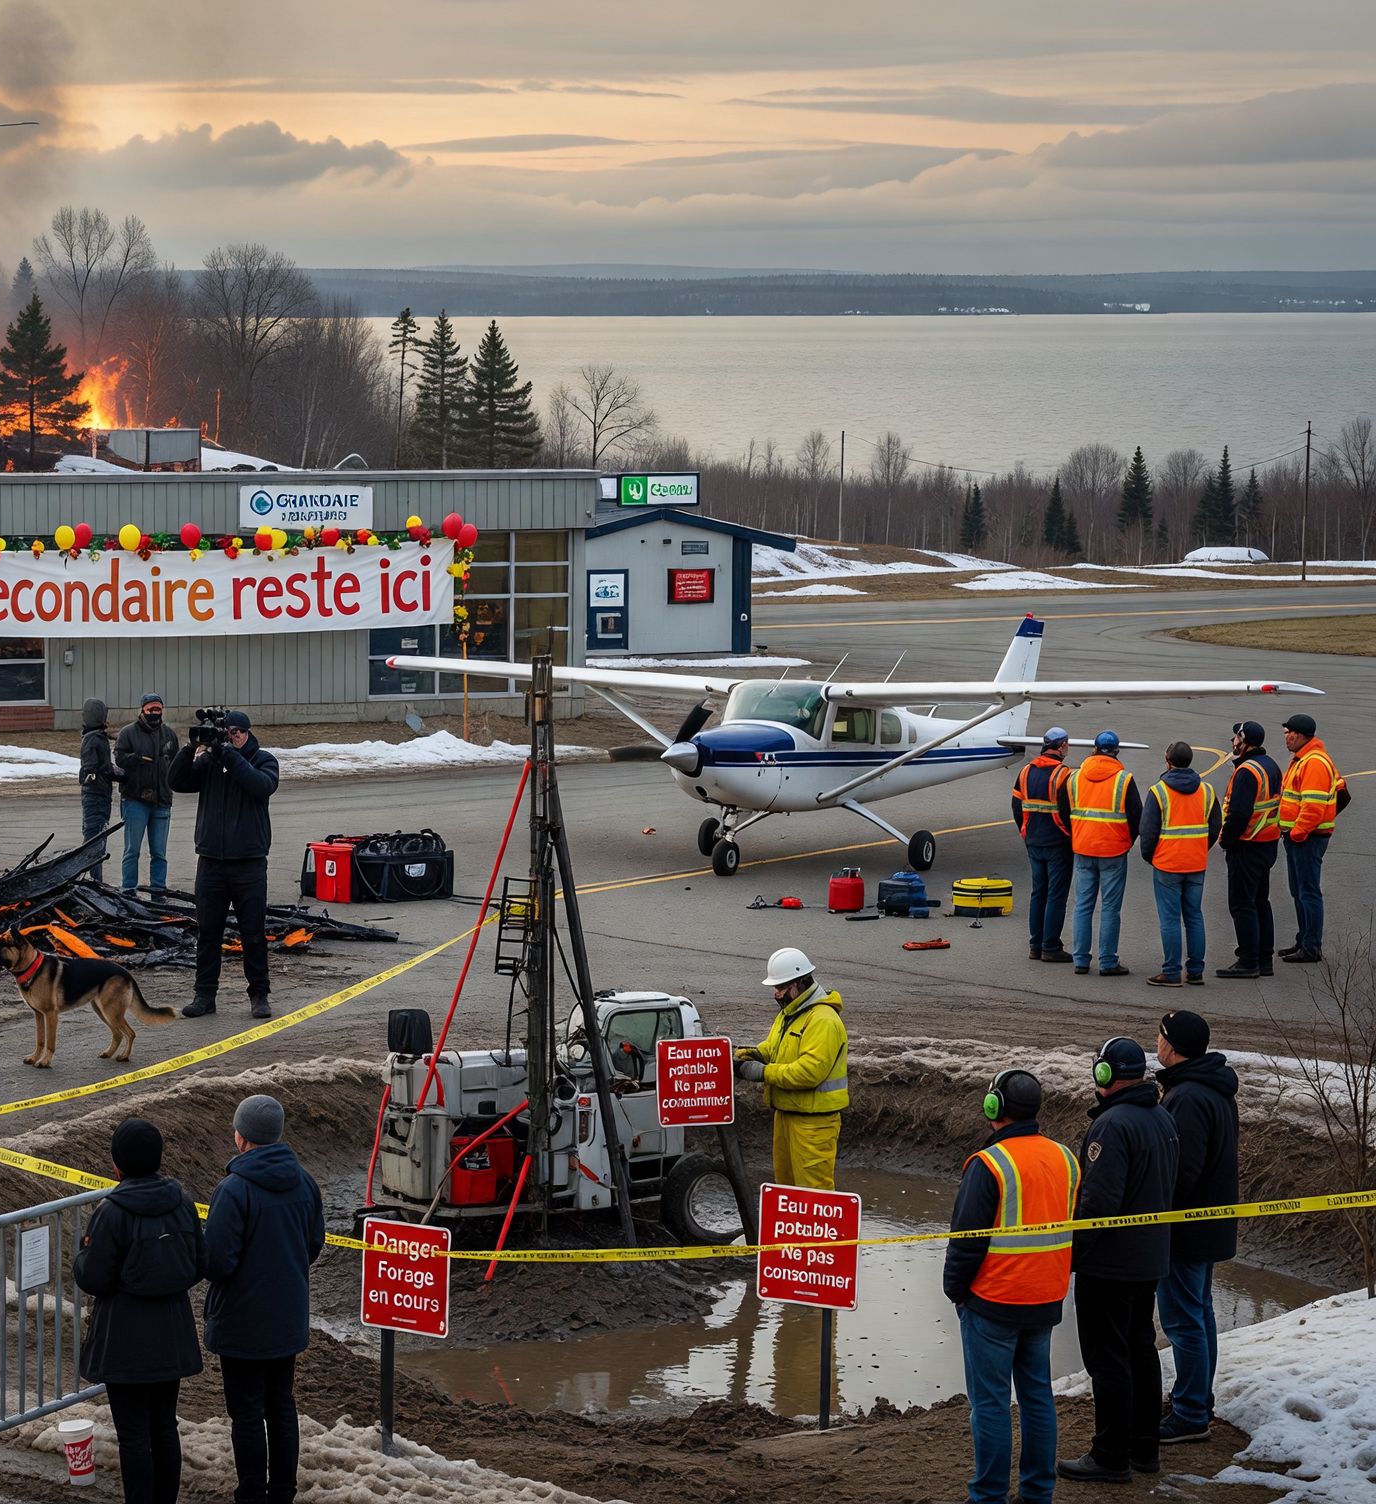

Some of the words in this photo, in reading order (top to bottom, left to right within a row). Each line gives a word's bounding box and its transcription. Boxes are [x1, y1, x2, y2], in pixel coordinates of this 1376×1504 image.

[232, 556, 361, 620] reste
[380, 555, 431, 614] ici
[778, 1195, 808, 1214] Eau
[813, 1203, 843, 1219] non
[774, 1221, 839, 1241] potable
[373, 1230, 440, 1261] Danger
[781, 1246, 802, 1261] Ne
[807, 1250, 835, 1266] pas
[378, 1260, 435, 1289] Forage
[763, 1266, 852, 1289] consommer
[368, 1289, 389, 1305] en
[393, 1293, 439, 1313] cours
